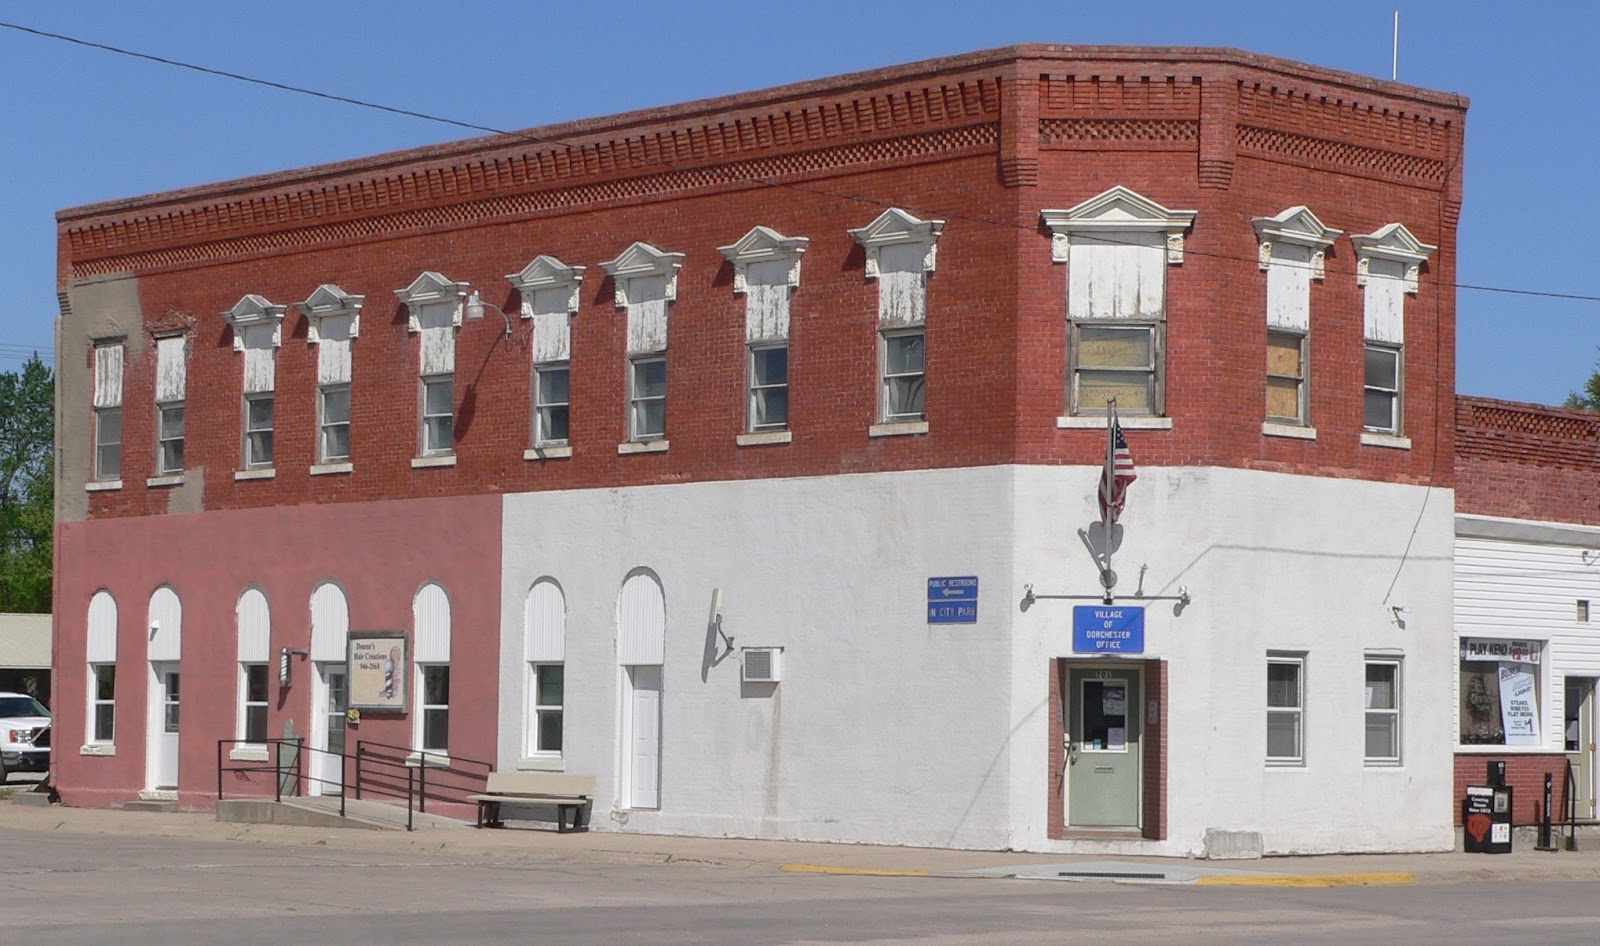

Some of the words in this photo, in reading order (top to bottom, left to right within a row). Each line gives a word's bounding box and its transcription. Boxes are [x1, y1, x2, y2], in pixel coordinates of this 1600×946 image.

[940, 607, 955, 617] CITY
[957, 606, 976, 616] PARK
[1095, 610, 1123, 618] VILLAGE
[1104, 620, 1113, 628] OF
[1086, 630, 1131, 639] DORCHESTER
[1096, 640, 1121, 649] OFFICE
[1470, 643, 1487, 655] PLAY
[1489, 643, 1507, 656] KENO
[365, 652, 388, 660] Creations
